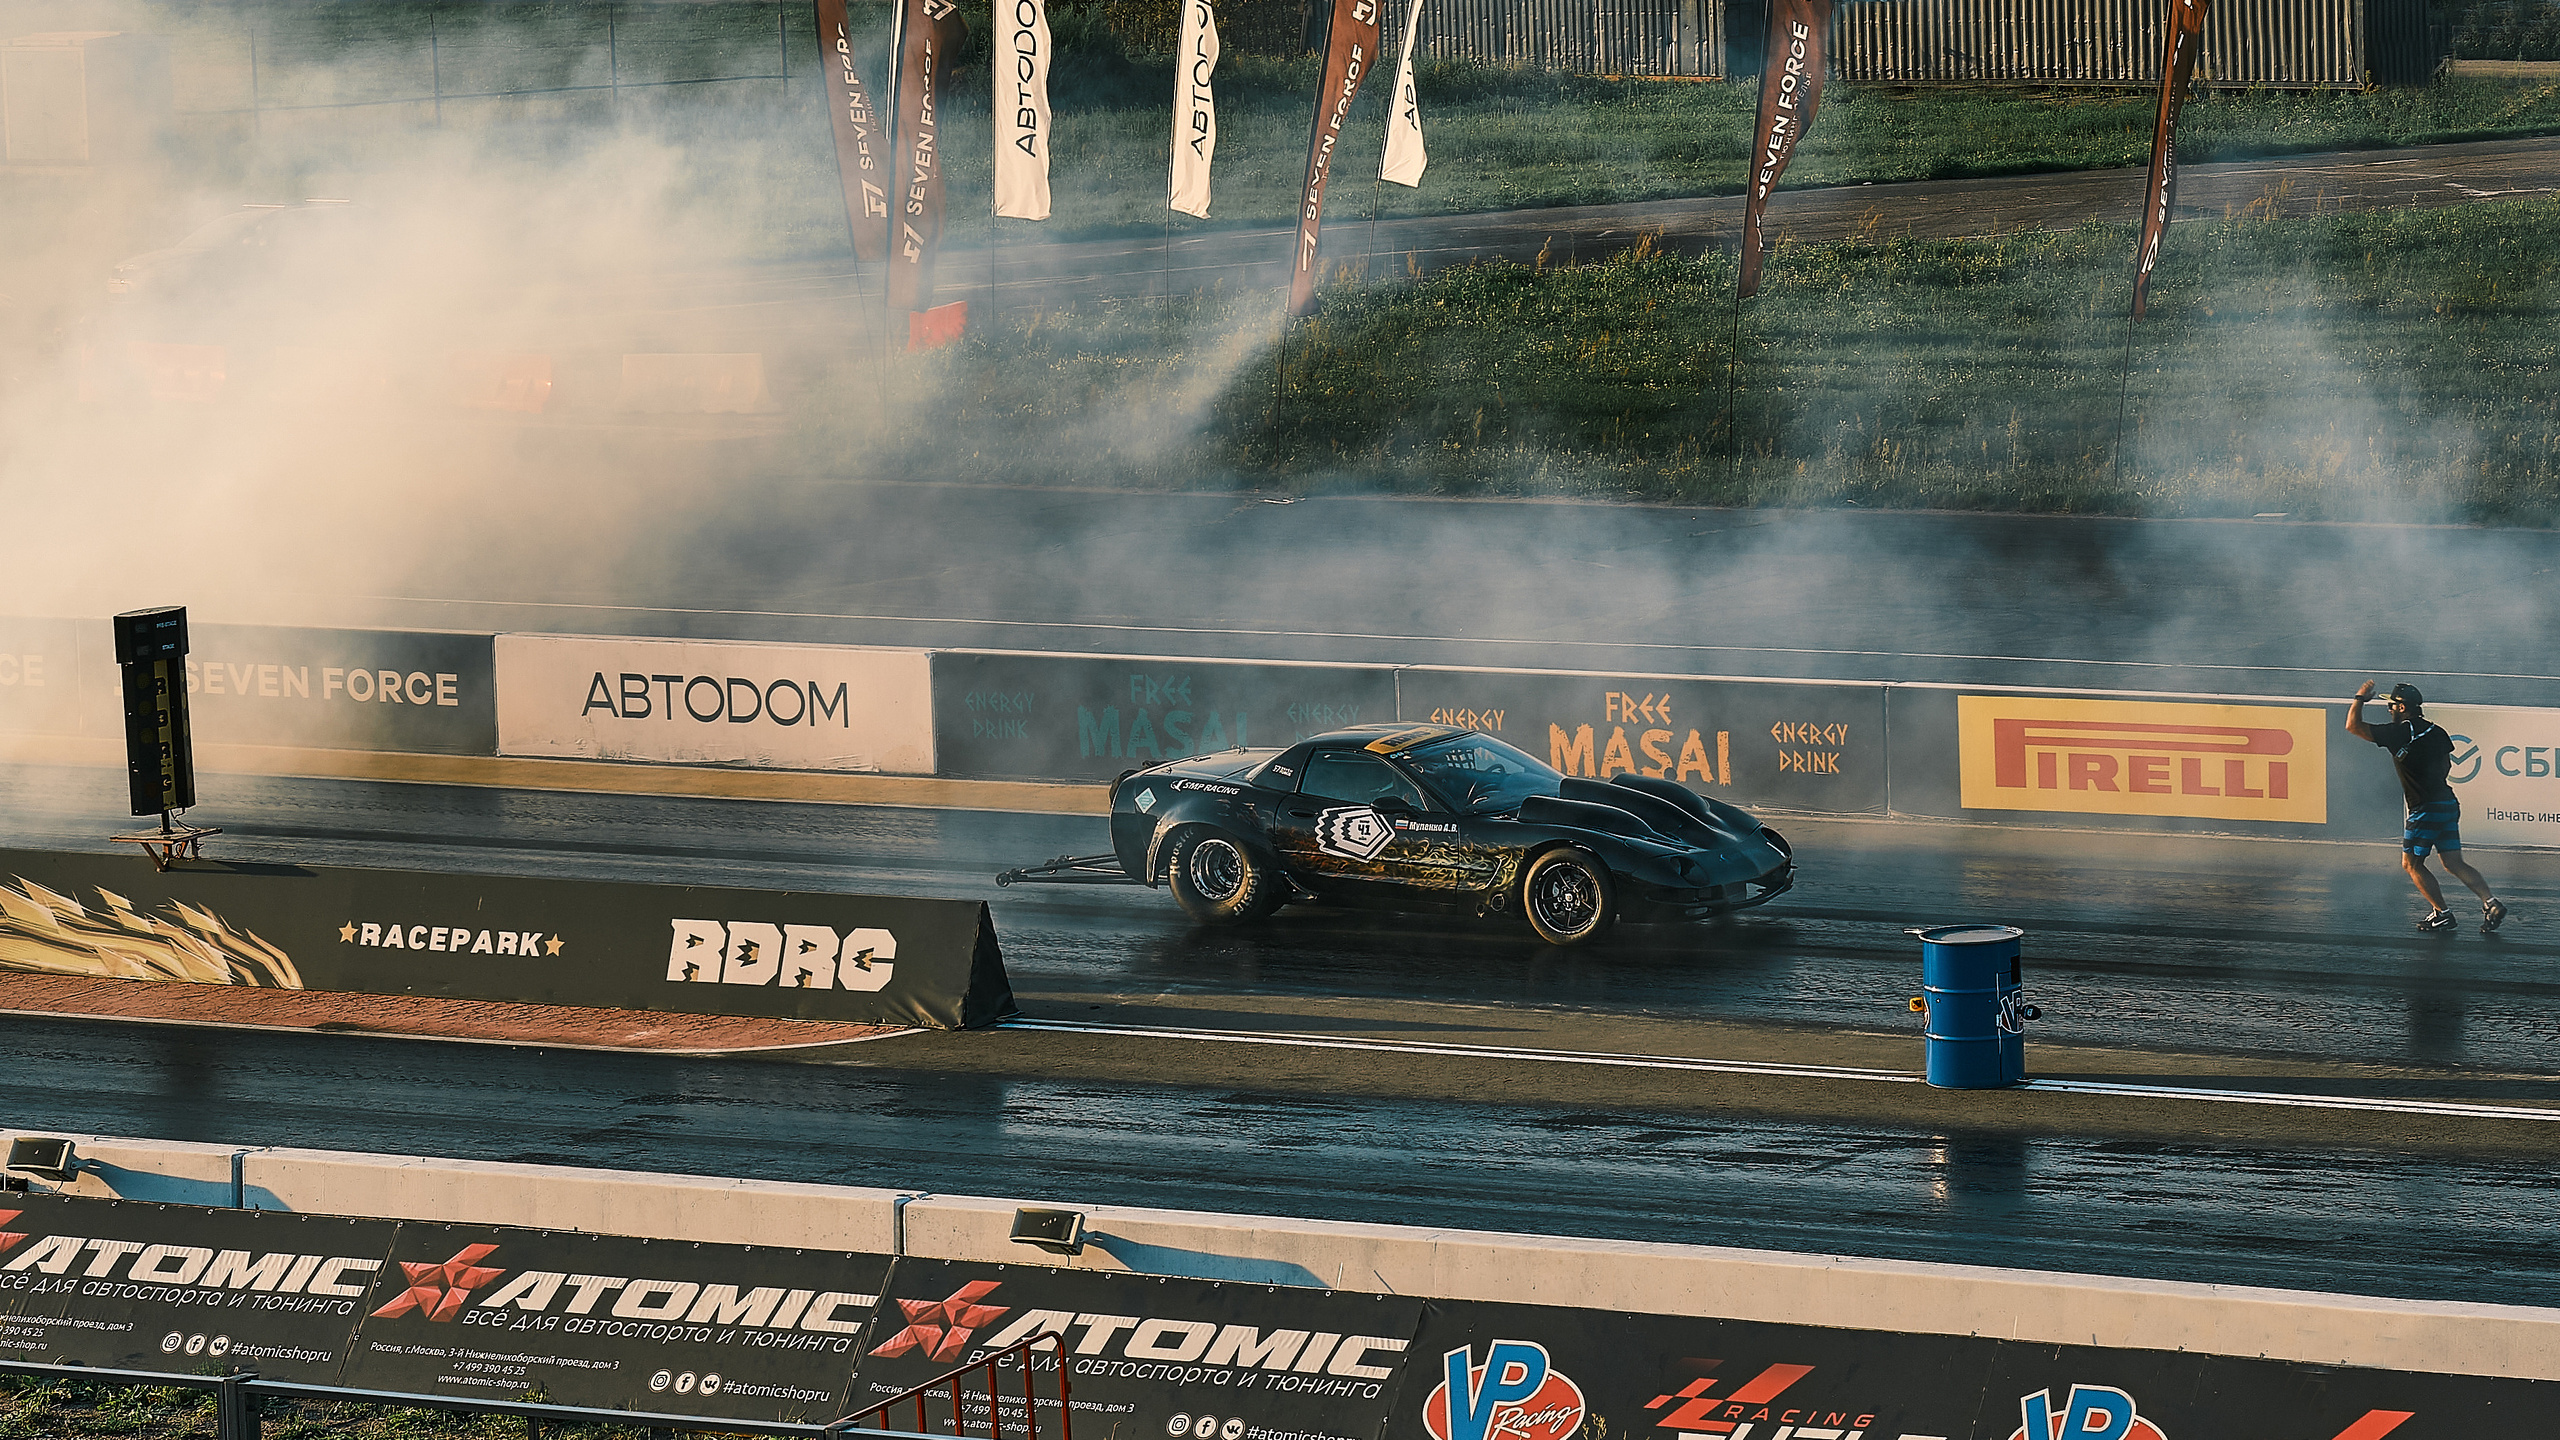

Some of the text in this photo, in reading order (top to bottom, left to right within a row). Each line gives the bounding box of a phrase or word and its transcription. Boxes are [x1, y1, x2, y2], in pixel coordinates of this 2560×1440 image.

[1777, 20, 1809, 110] FORCE
[906, 131, 934, 216] SEVEN
[1306, 134, 1336, 221] SEVEN
[323, 667, 459, 706] FORCE
[965, 691, 1035, 714] ENERGY
[1130, 673, 1192, 706] FREE
[1287, 702, 1360, 725] ENERGY
[1430, 707, 1505, 731] ENERGY
[1605, 691, 1671, 726] FREE
[973, 718, 1029, 739] DRINK
[1077, 704, 1249, 759] MASAI
[1770, 720, 1848, 748] ENERGY
[1549, 722, 1732, 787] MASAI
[1779, 748, 1841, 775] DRINK
[1994, 718, 2294, 800] PIRELLI
[1182, 781, 1241, 795] SMP RACING
[2487, 807, 2535, 823] Начать
[359, 921, 544, 957] RACEPARK
[666, 918, 898, 993] RDRC
[1, 1235, 384, 1298] ATOMIC
[29, 1277, 79, 1295] для
[82, 1280, 225, 1308] автоспорта
[227, 1292, 247, 1309] и
[251, 1294, 357, 1316] тюнинга
[478, 1270, 881, 1334] ATOMIC
[2, 1326, 45, 1338] 390 45 25
[106, 1322, 126, 1332] дом
[126, 1322, 135, 1332] 3
[462, 1308, 853, 1354] всё для автоспорта и тюнинга
[231, 1341, 332, 1363] #atomicshopru
[370, 1341, 621, 1370] Россия, г.Москва, 3-й Нижнелихоборский проезд, дом 3
[982, 1308, 1411, 1380] ATOMIC
[437, 1374, 530, 1390] www.atomic-shop.ru
[452, 1361, 527, 1376] +7 499 390 45 25
[1075, 1356, 1234, 1387] автоспорта
[1237, 1371, 1259, 1389] и
[1265, 1373, 1384, 1400] тюнинга
[723, 1379, 832, 1404] #atomicshopru
[1443, 1338, 1551, 1440] VP
[971, 1404, 991, 1416] 499
[1011, 1408, 1025, 1418] 45
[1105, 1403, 1126, 1413] дом
[1126, 1403, 1135, 1413] 3
[1493, 1402, 1582, 1440] Racing
[1723, 1404, 1876, 1428] RACING
